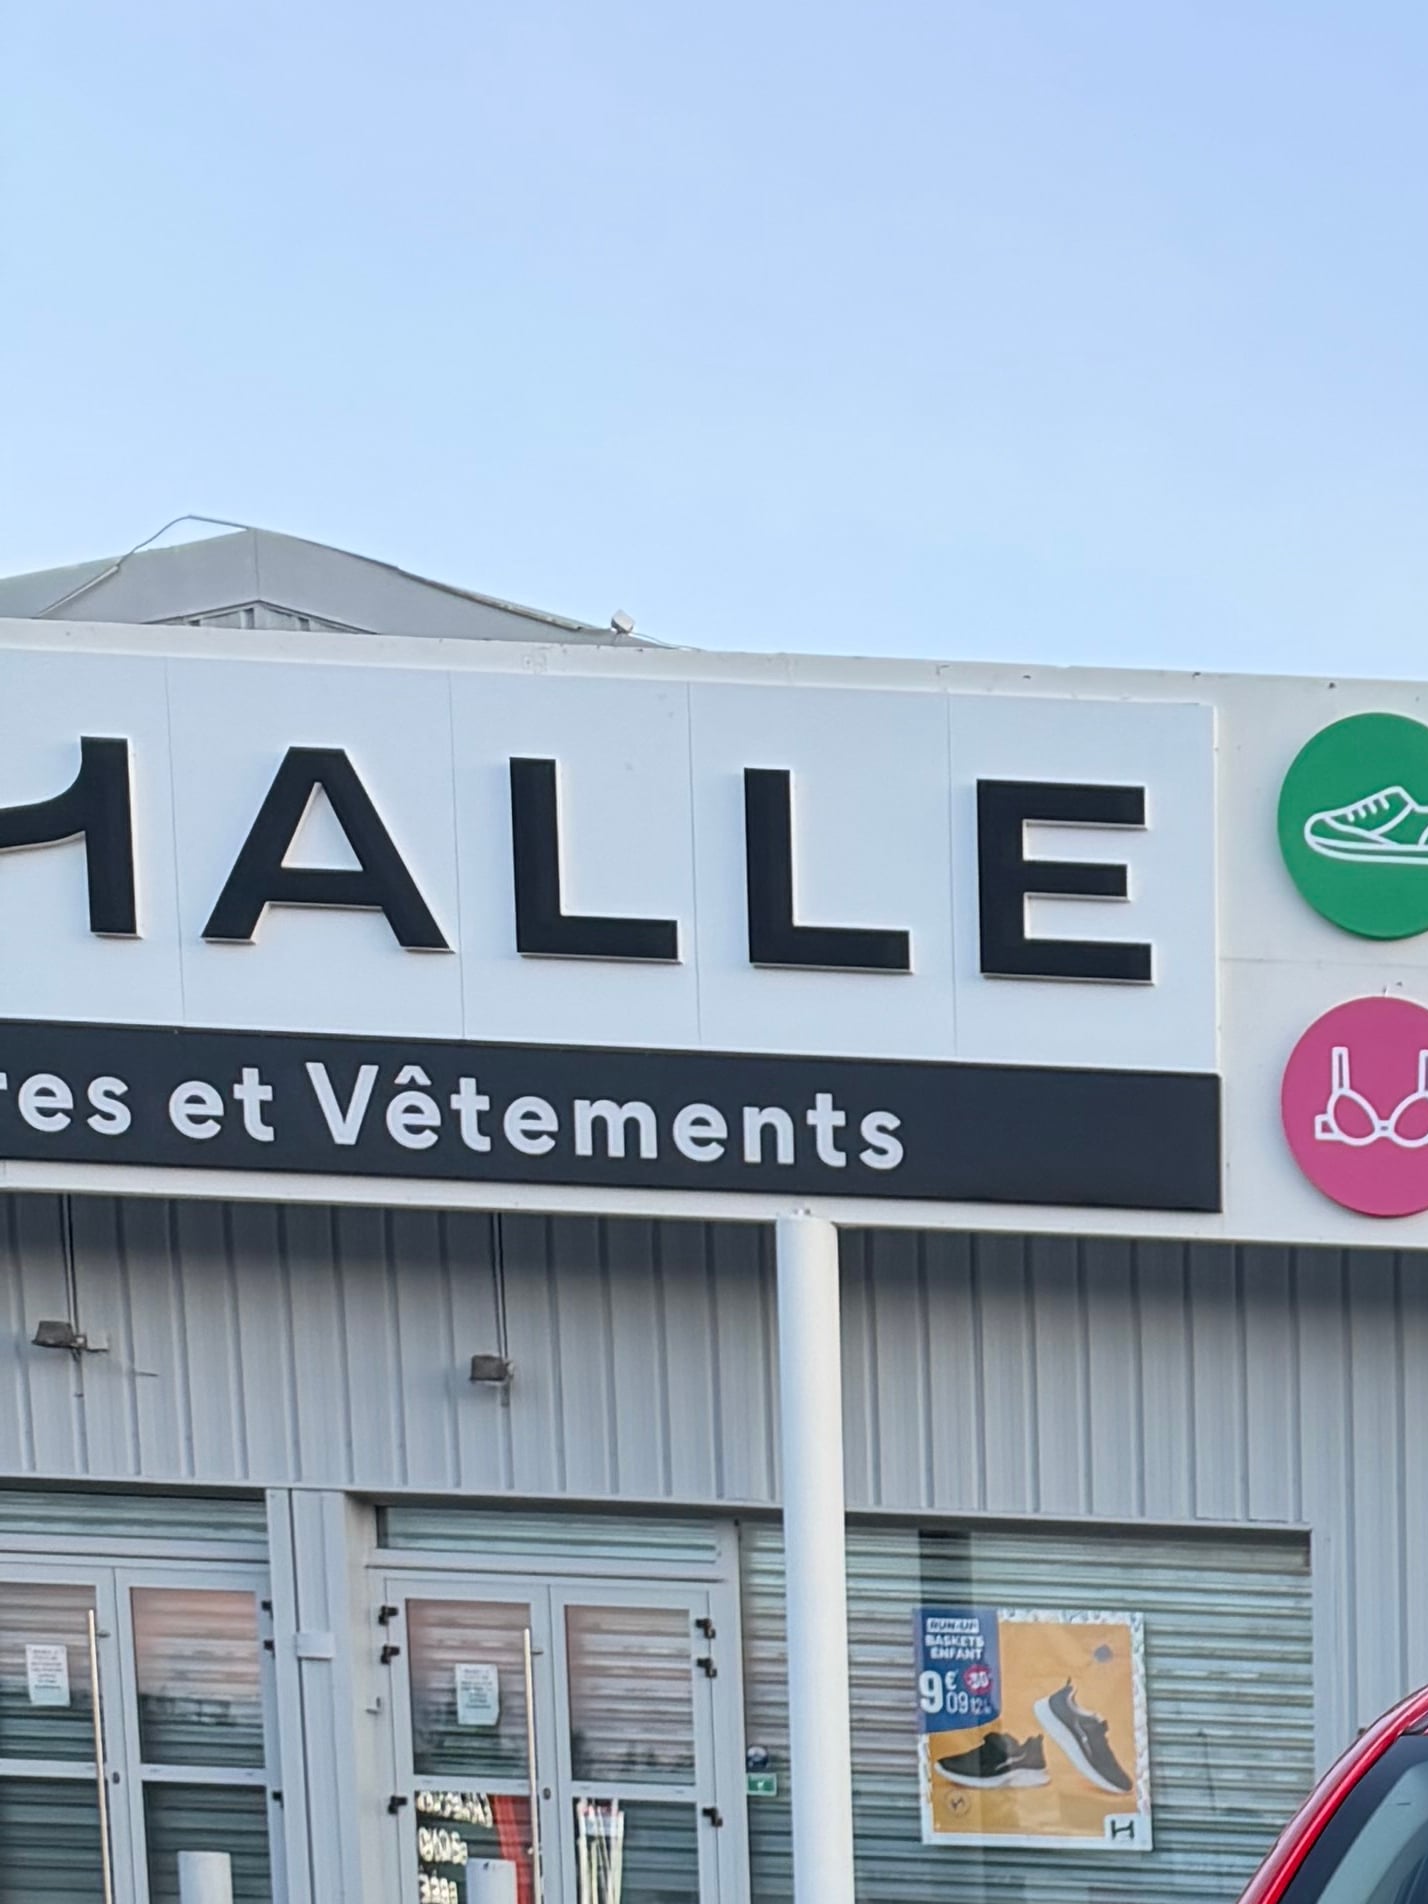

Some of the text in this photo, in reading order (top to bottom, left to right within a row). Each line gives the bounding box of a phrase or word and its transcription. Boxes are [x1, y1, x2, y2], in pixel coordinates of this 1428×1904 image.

[0, 1061, 906, 1171] res et Vêtements
[1111, 1819, 1135, 1840] H
